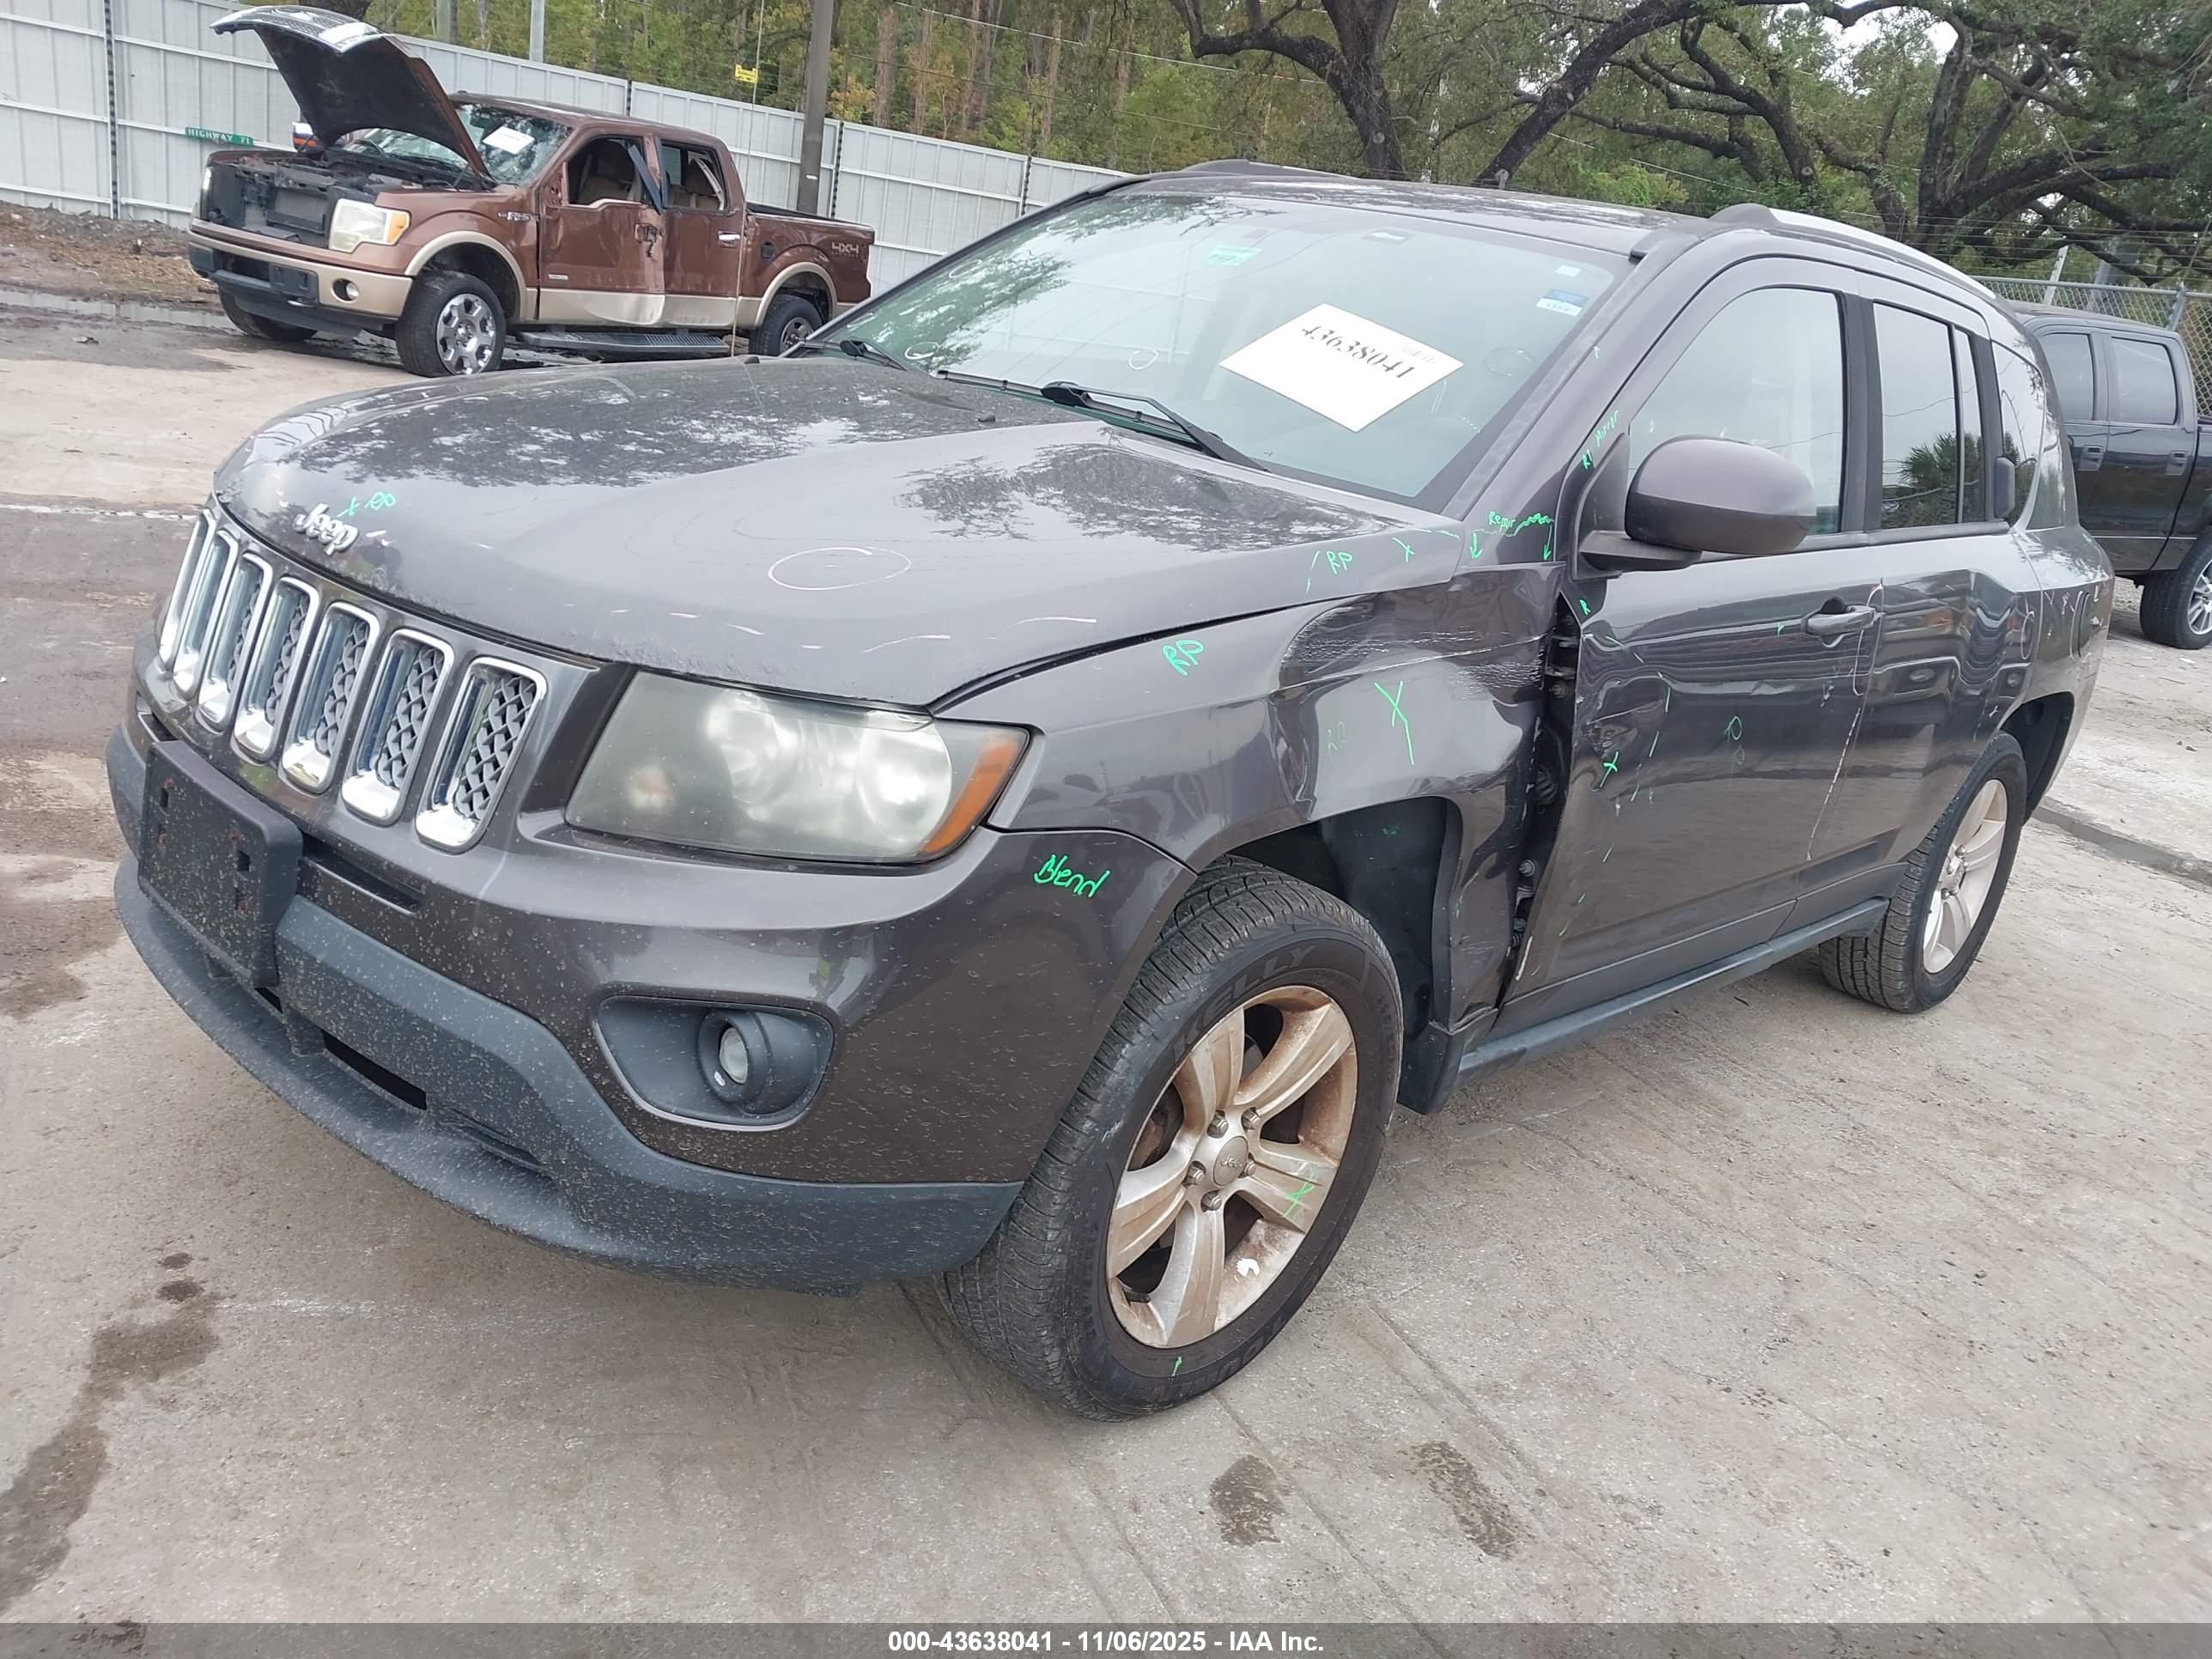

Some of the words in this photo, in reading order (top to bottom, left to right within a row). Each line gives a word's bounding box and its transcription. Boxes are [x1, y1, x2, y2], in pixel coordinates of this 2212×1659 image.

[188, 128, 233, 144] HIGHWAY
[240, 137, 250, 145] 71
[831, 241, 860, 255] 4X4
[1301, 325, 1415, 379] 43638041
[291, 502, 360, 557] Jeep
[1326, 550, 1353, 574] RP
[1162, 639, 1205, 677] RP
[1033, 853, 1111, 898] Blend
